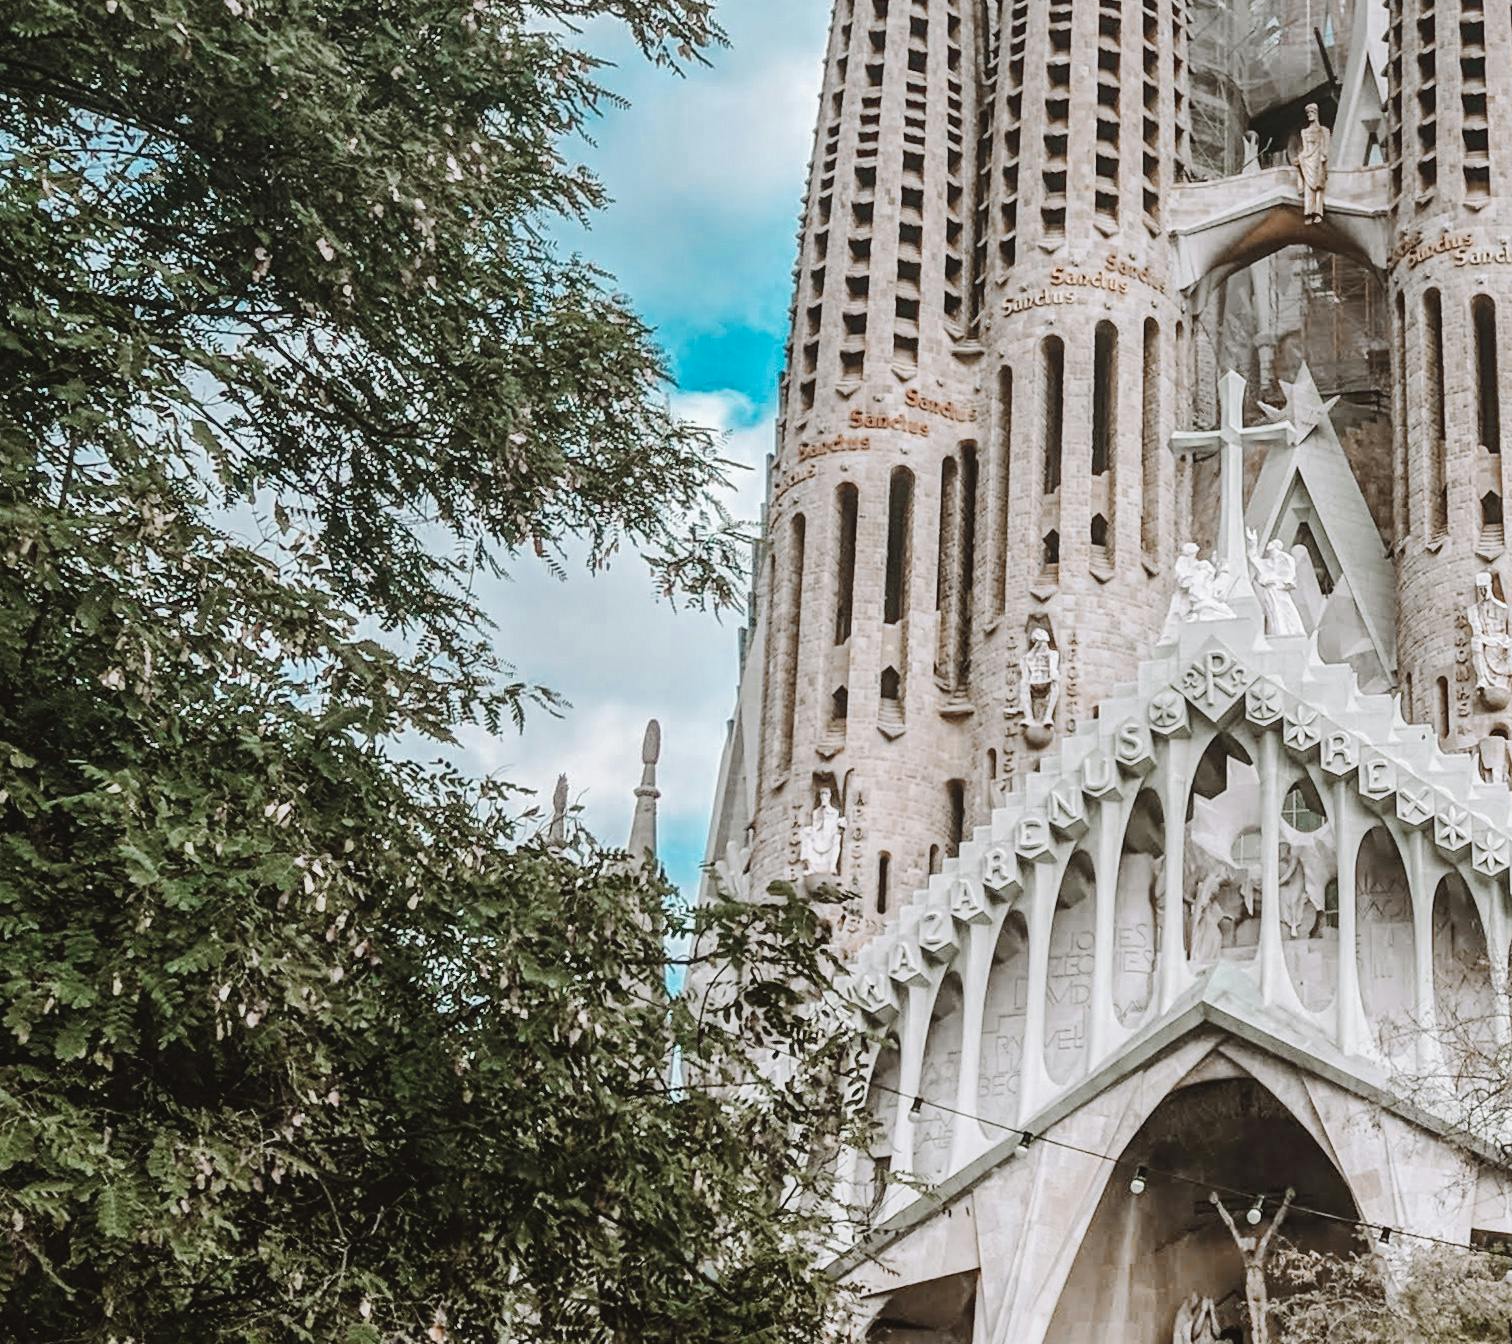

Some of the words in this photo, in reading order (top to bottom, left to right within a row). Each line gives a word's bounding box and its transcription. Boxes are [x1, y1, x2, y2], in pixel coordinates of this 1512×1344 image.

[1050, 266, 1128, 294] Sanctus
[1002, 289, 1075, 317] Sanctus
[906, 388, 977, 422] Sanctus
[850, 409, 929, 437] Sanctus
[1325, 730, 1432, 817] REX
